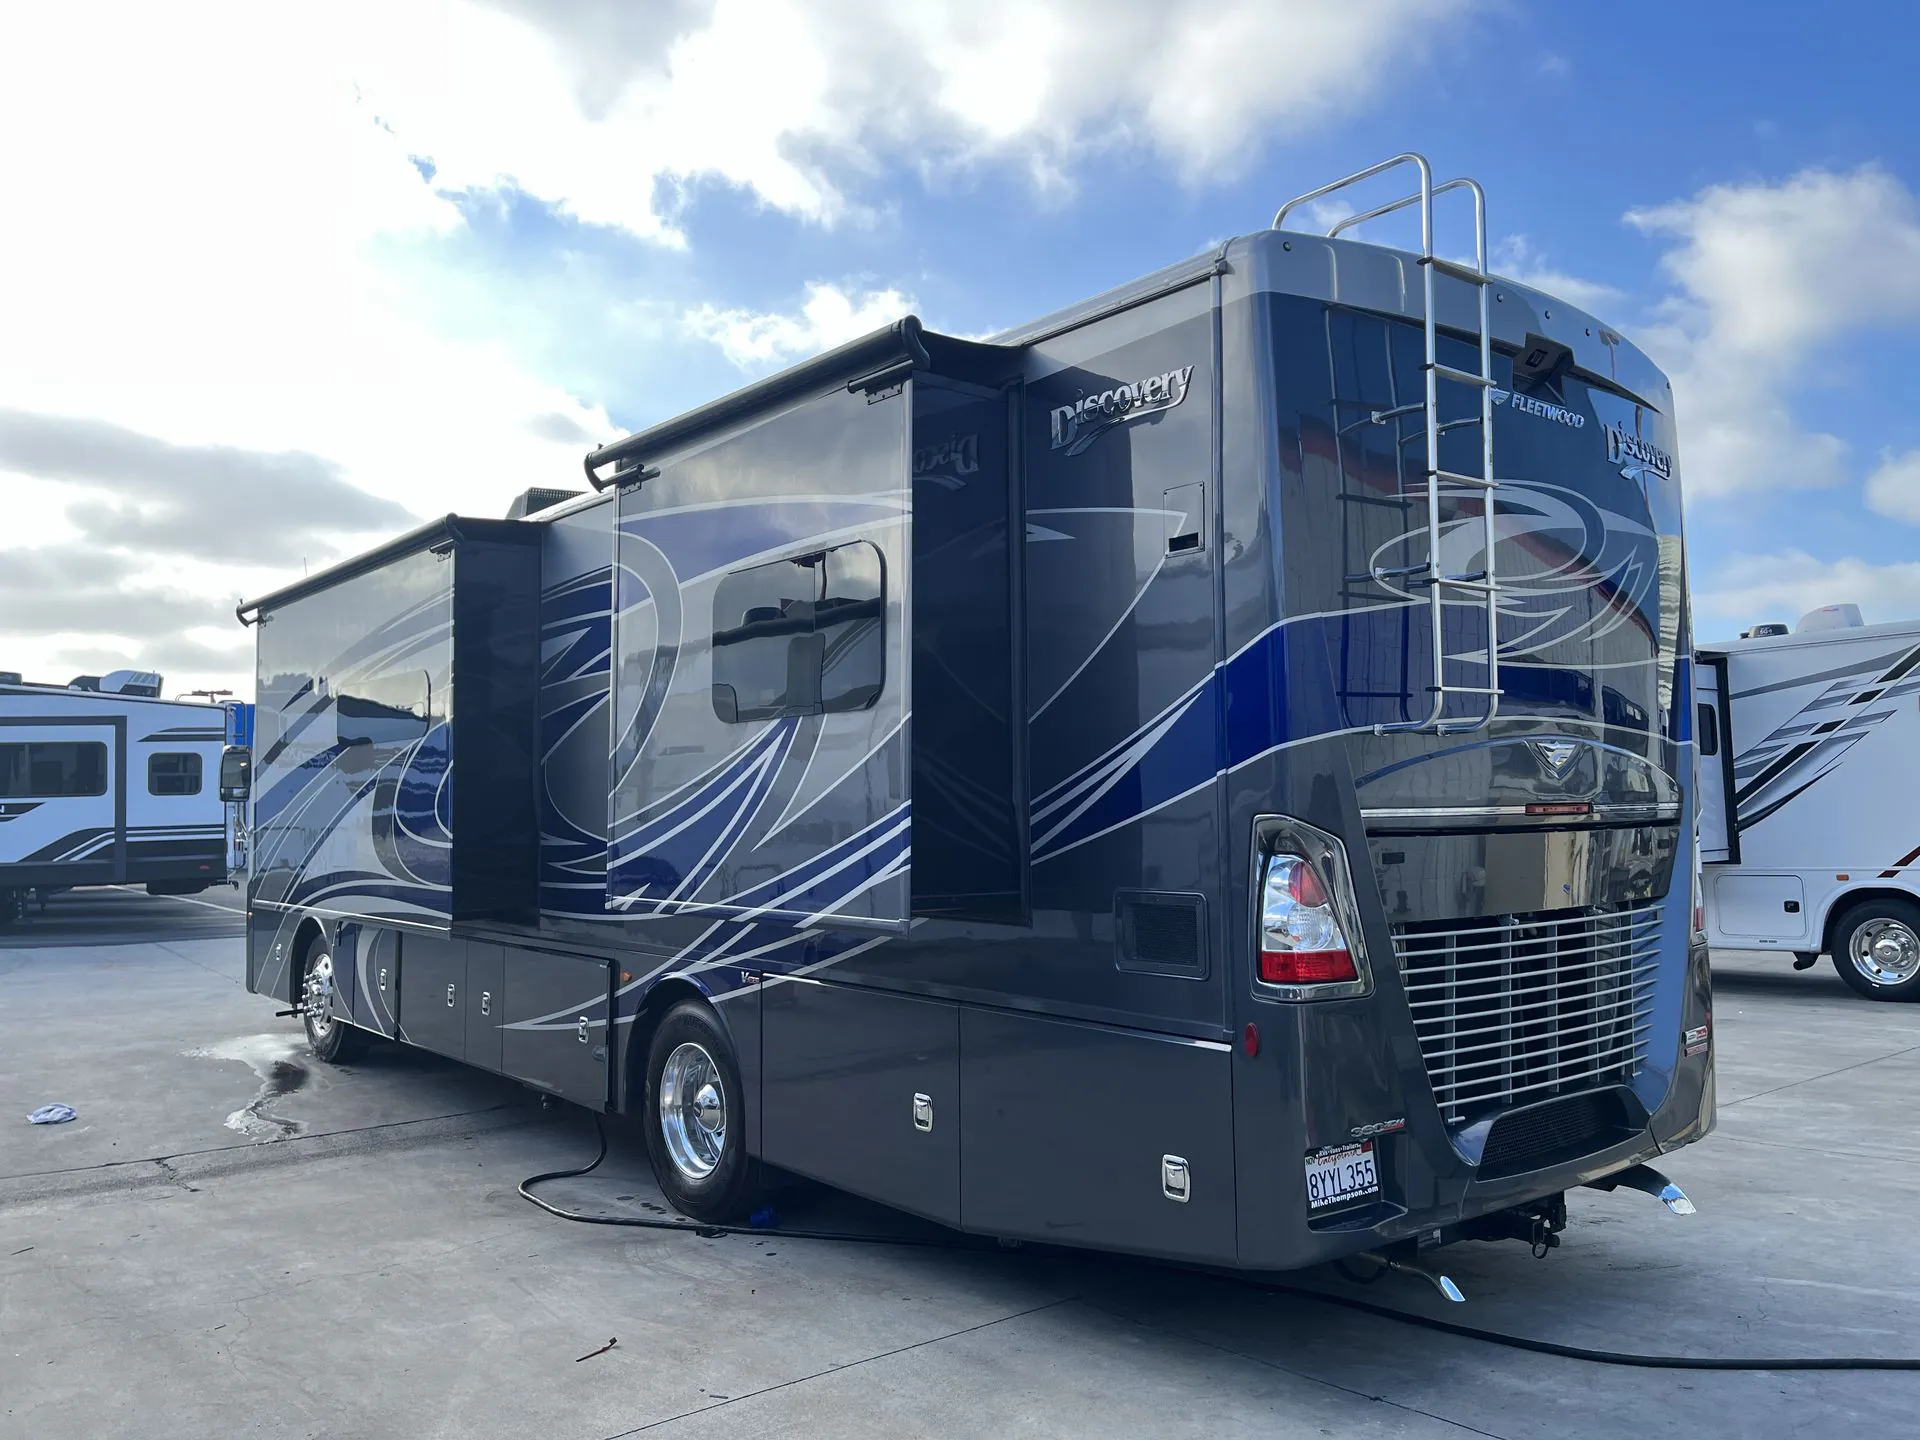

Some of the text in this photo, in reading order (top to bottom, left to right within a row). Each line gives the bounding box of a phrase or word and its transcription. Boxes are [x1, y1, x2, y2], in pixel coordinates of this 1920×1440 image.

[1050, 365, 1195, 456] Discovery
[1511, 392, 1585, 429] FLEETWOOD
[1309, 1160, 1374, 1199] 8YYL355
